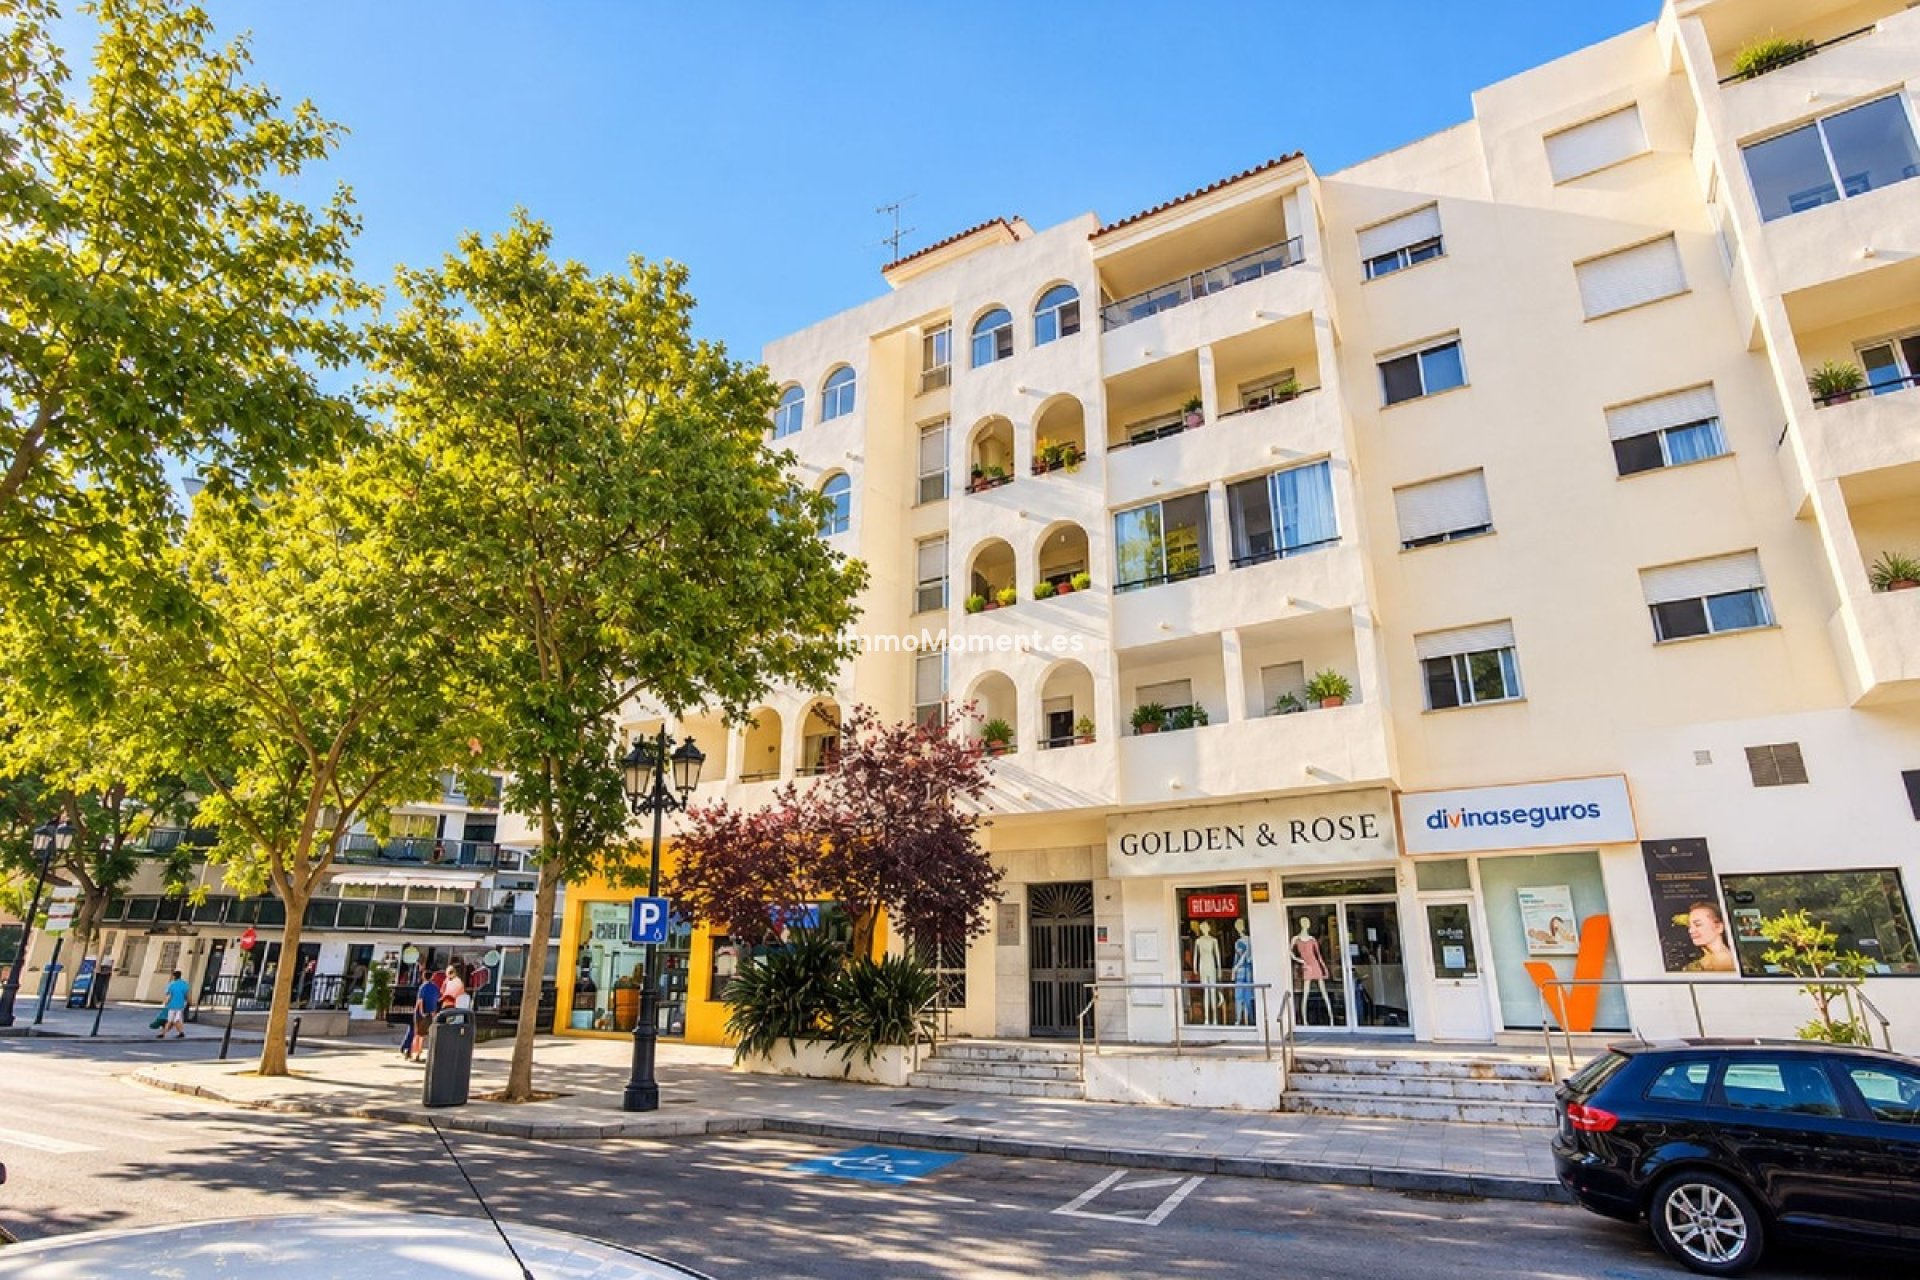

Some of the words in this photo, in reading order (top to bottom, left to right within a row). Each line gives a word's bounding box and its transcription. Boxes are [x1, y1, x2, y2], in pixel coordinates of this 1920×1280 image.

[1426, 802, 1601, 829] divinaseguros
[1120, 825, 1245, 856] GOLDEN
[1256, 822, 1278, 847] &
[1289, 813, 1379, 844] ROSE
[639, 903, 660, 936] P
